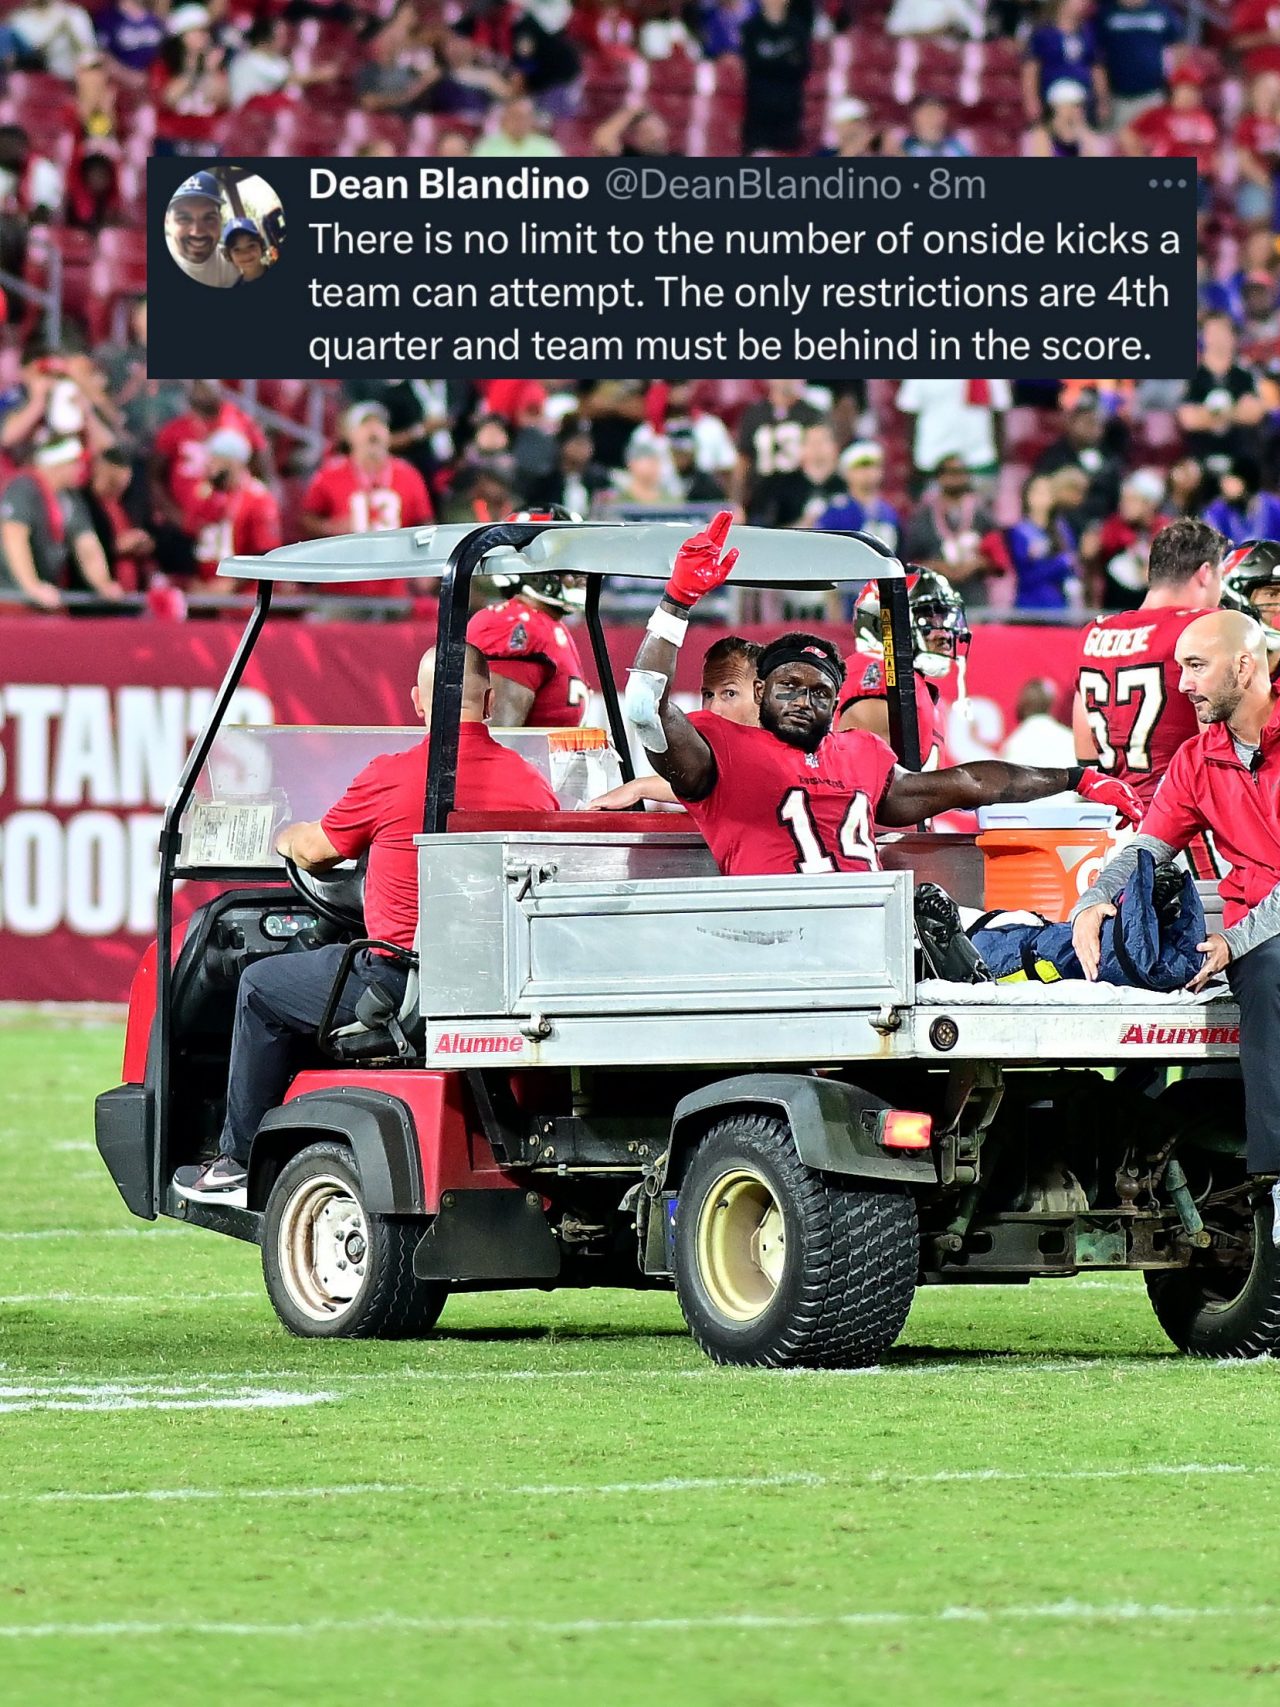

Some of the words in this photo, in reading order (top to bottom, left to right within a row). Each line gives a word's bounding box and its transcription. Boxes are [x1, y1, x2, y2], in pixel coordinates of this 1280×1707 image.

[0, 684, 274, 806] TAN'S
[1077, 662, 1167, 773] 67
[776, 787, 883, 873] 14
[435, 1033, 524, 1054] Alumne
